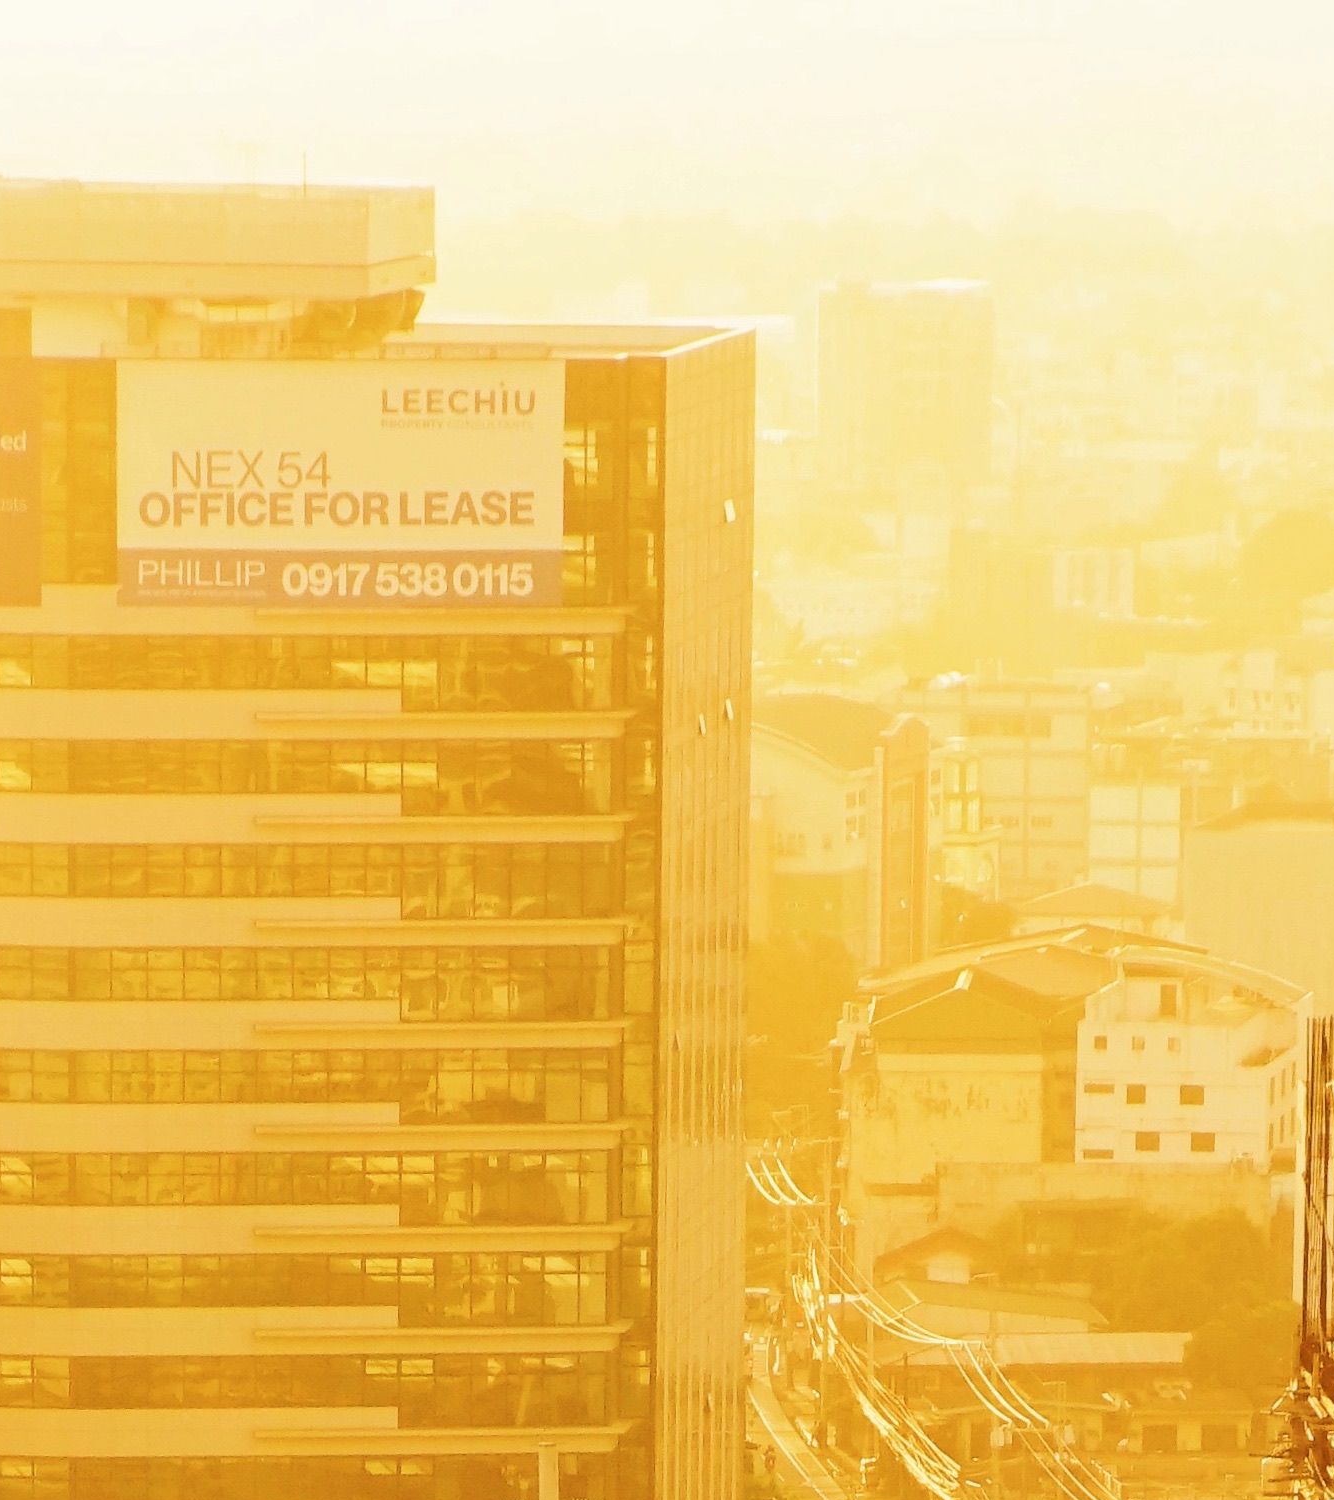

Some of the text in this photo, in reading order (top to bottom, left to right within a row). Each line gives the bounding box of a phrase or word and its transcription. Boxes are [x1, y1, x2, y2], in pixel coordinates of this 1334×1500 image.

[170, 449, 332, 489] NEX 54
[138, 490, 536, 528] OFFICE FOR LEASE
[137, 559, 535, 598] PHILLIP 0917 538 0115
